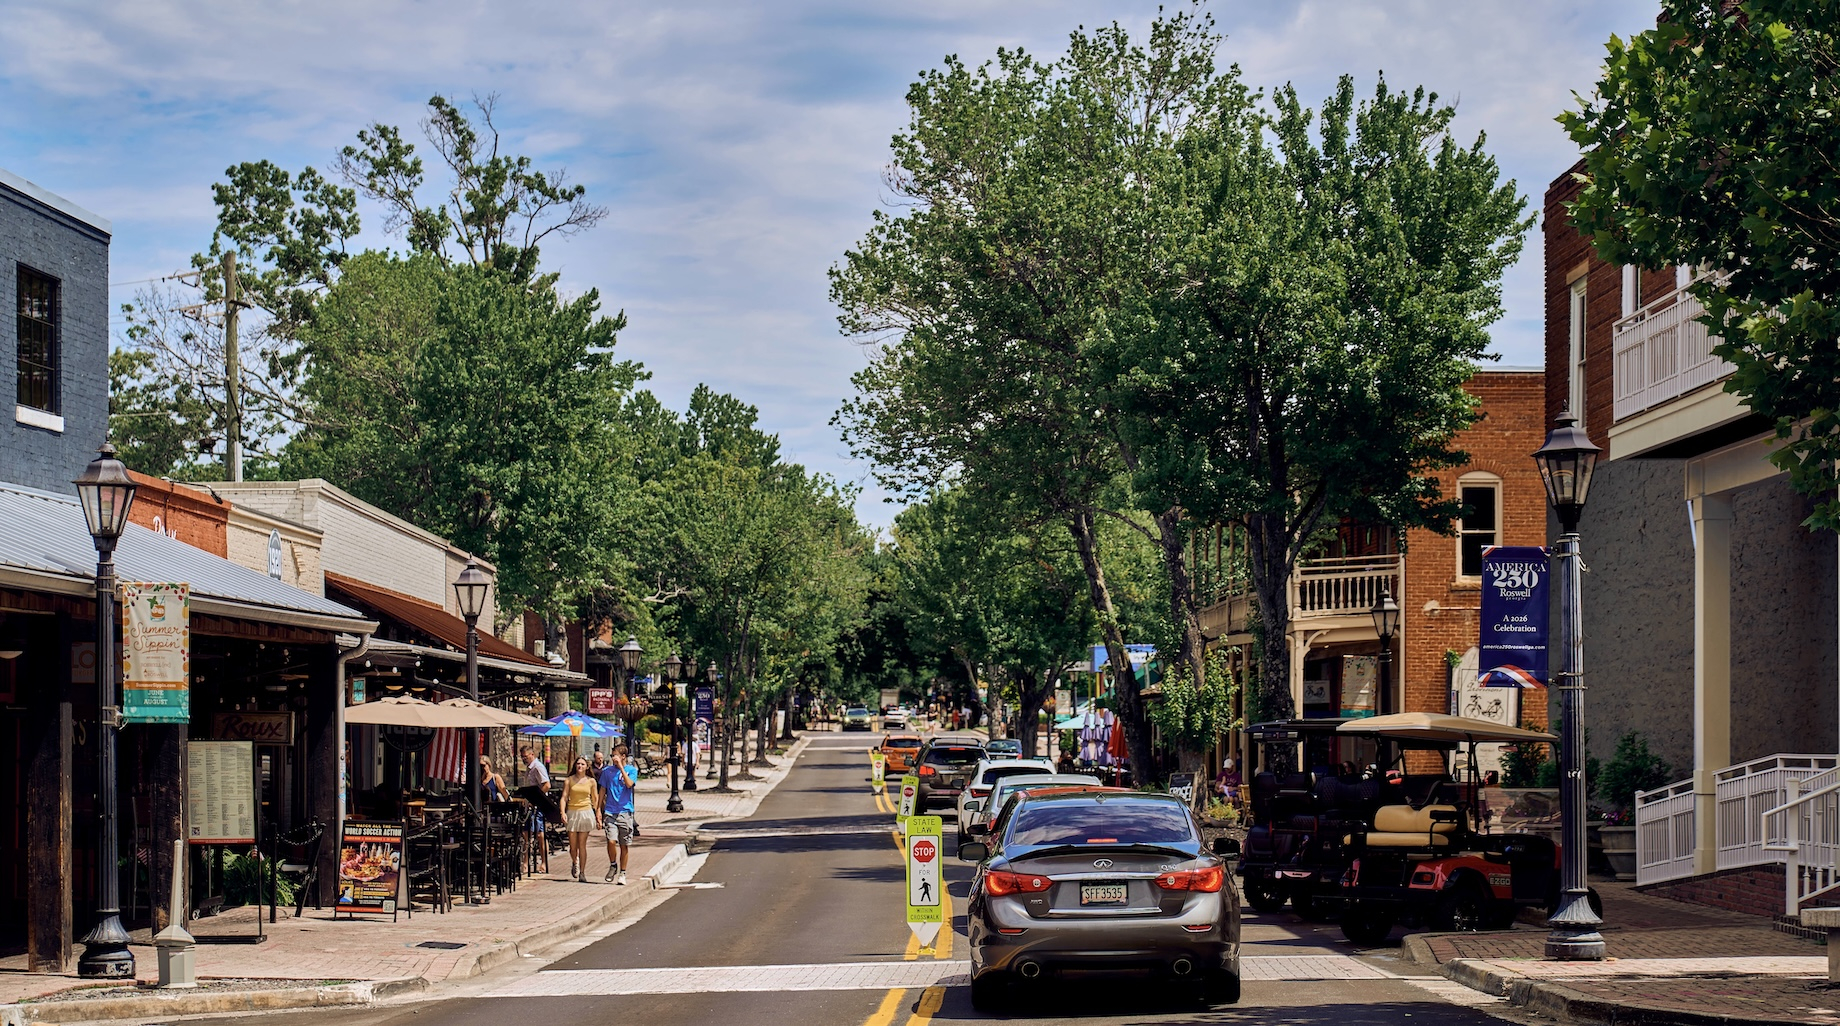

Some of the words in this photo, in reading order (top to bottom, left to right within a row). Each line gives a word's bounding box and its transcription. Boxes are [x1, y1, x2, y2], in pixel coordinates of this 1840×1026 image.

[1485, 562, 1546, 572] AMERICA
[1492, 569, 1539, 589] 250
[1500, 588, 1531, 598] Roswell
[1502, 614, 1510, 622] A
[1510, 614, 1528, 622] 2026
[130, 621, 181, 638] Summer
[1493, 623, 1537, 632] Celebration
[133, 635, 181, 654] Sippin'
[221, 714, 284, 740] Roux
[912, 818, 936, 826] STATE
[344, 827, 362, 836] WORLD
[362, 827, 382, 836] SOCCER
[383, 828, 402, 837] ACTION
[916, 826, 932, 834] LAW
[914, 846, 935, 857] STOP
[1084, 887, 1123, 900] SFF3535
